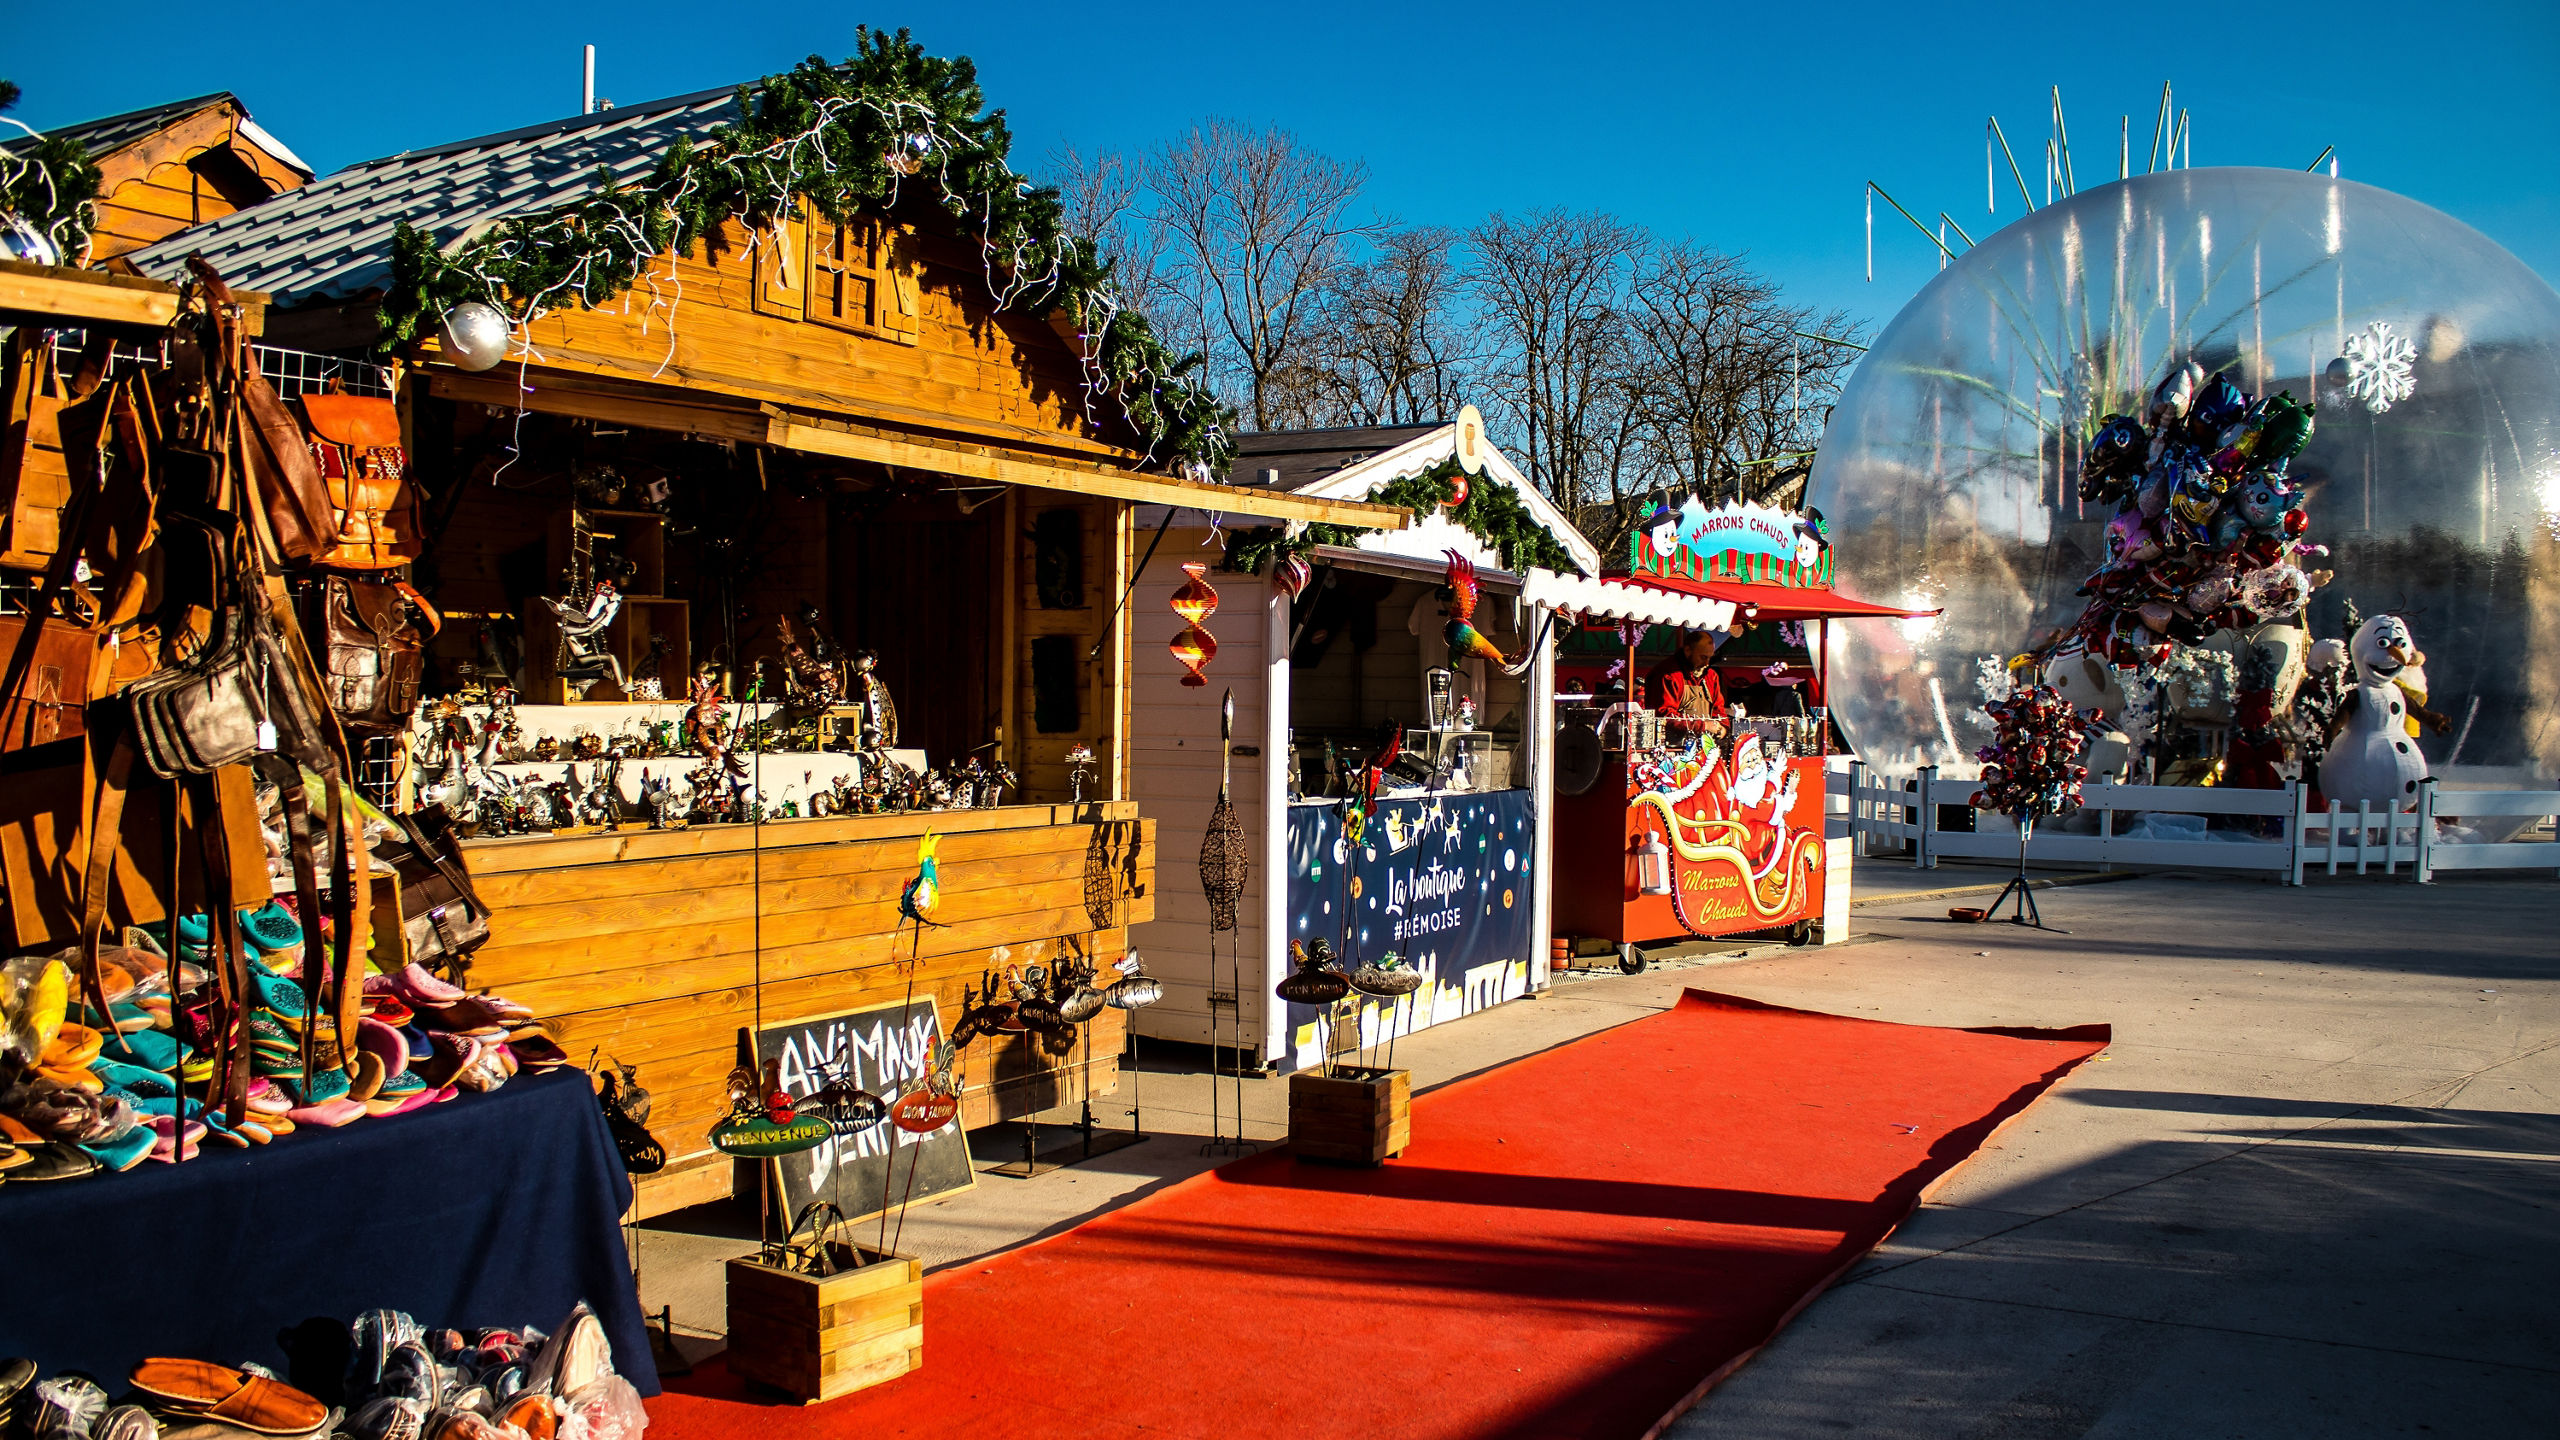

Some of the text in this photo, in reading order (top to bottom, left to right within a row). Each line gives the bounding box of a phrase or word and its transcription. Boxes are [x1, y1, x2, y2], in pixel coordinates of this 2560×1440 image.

[1692, 516, 1789, 549] MARRONS CHAUDS
[1386, 856, 1466, 916] La boutique
[1682, 869, 1740, 891] Marrons
[1393, 907, 1461, 941] #RÉMOISE
[1699, 897, 1749, 925] Chauds
[720, 1124, 826, 1147] BIENVENUE
